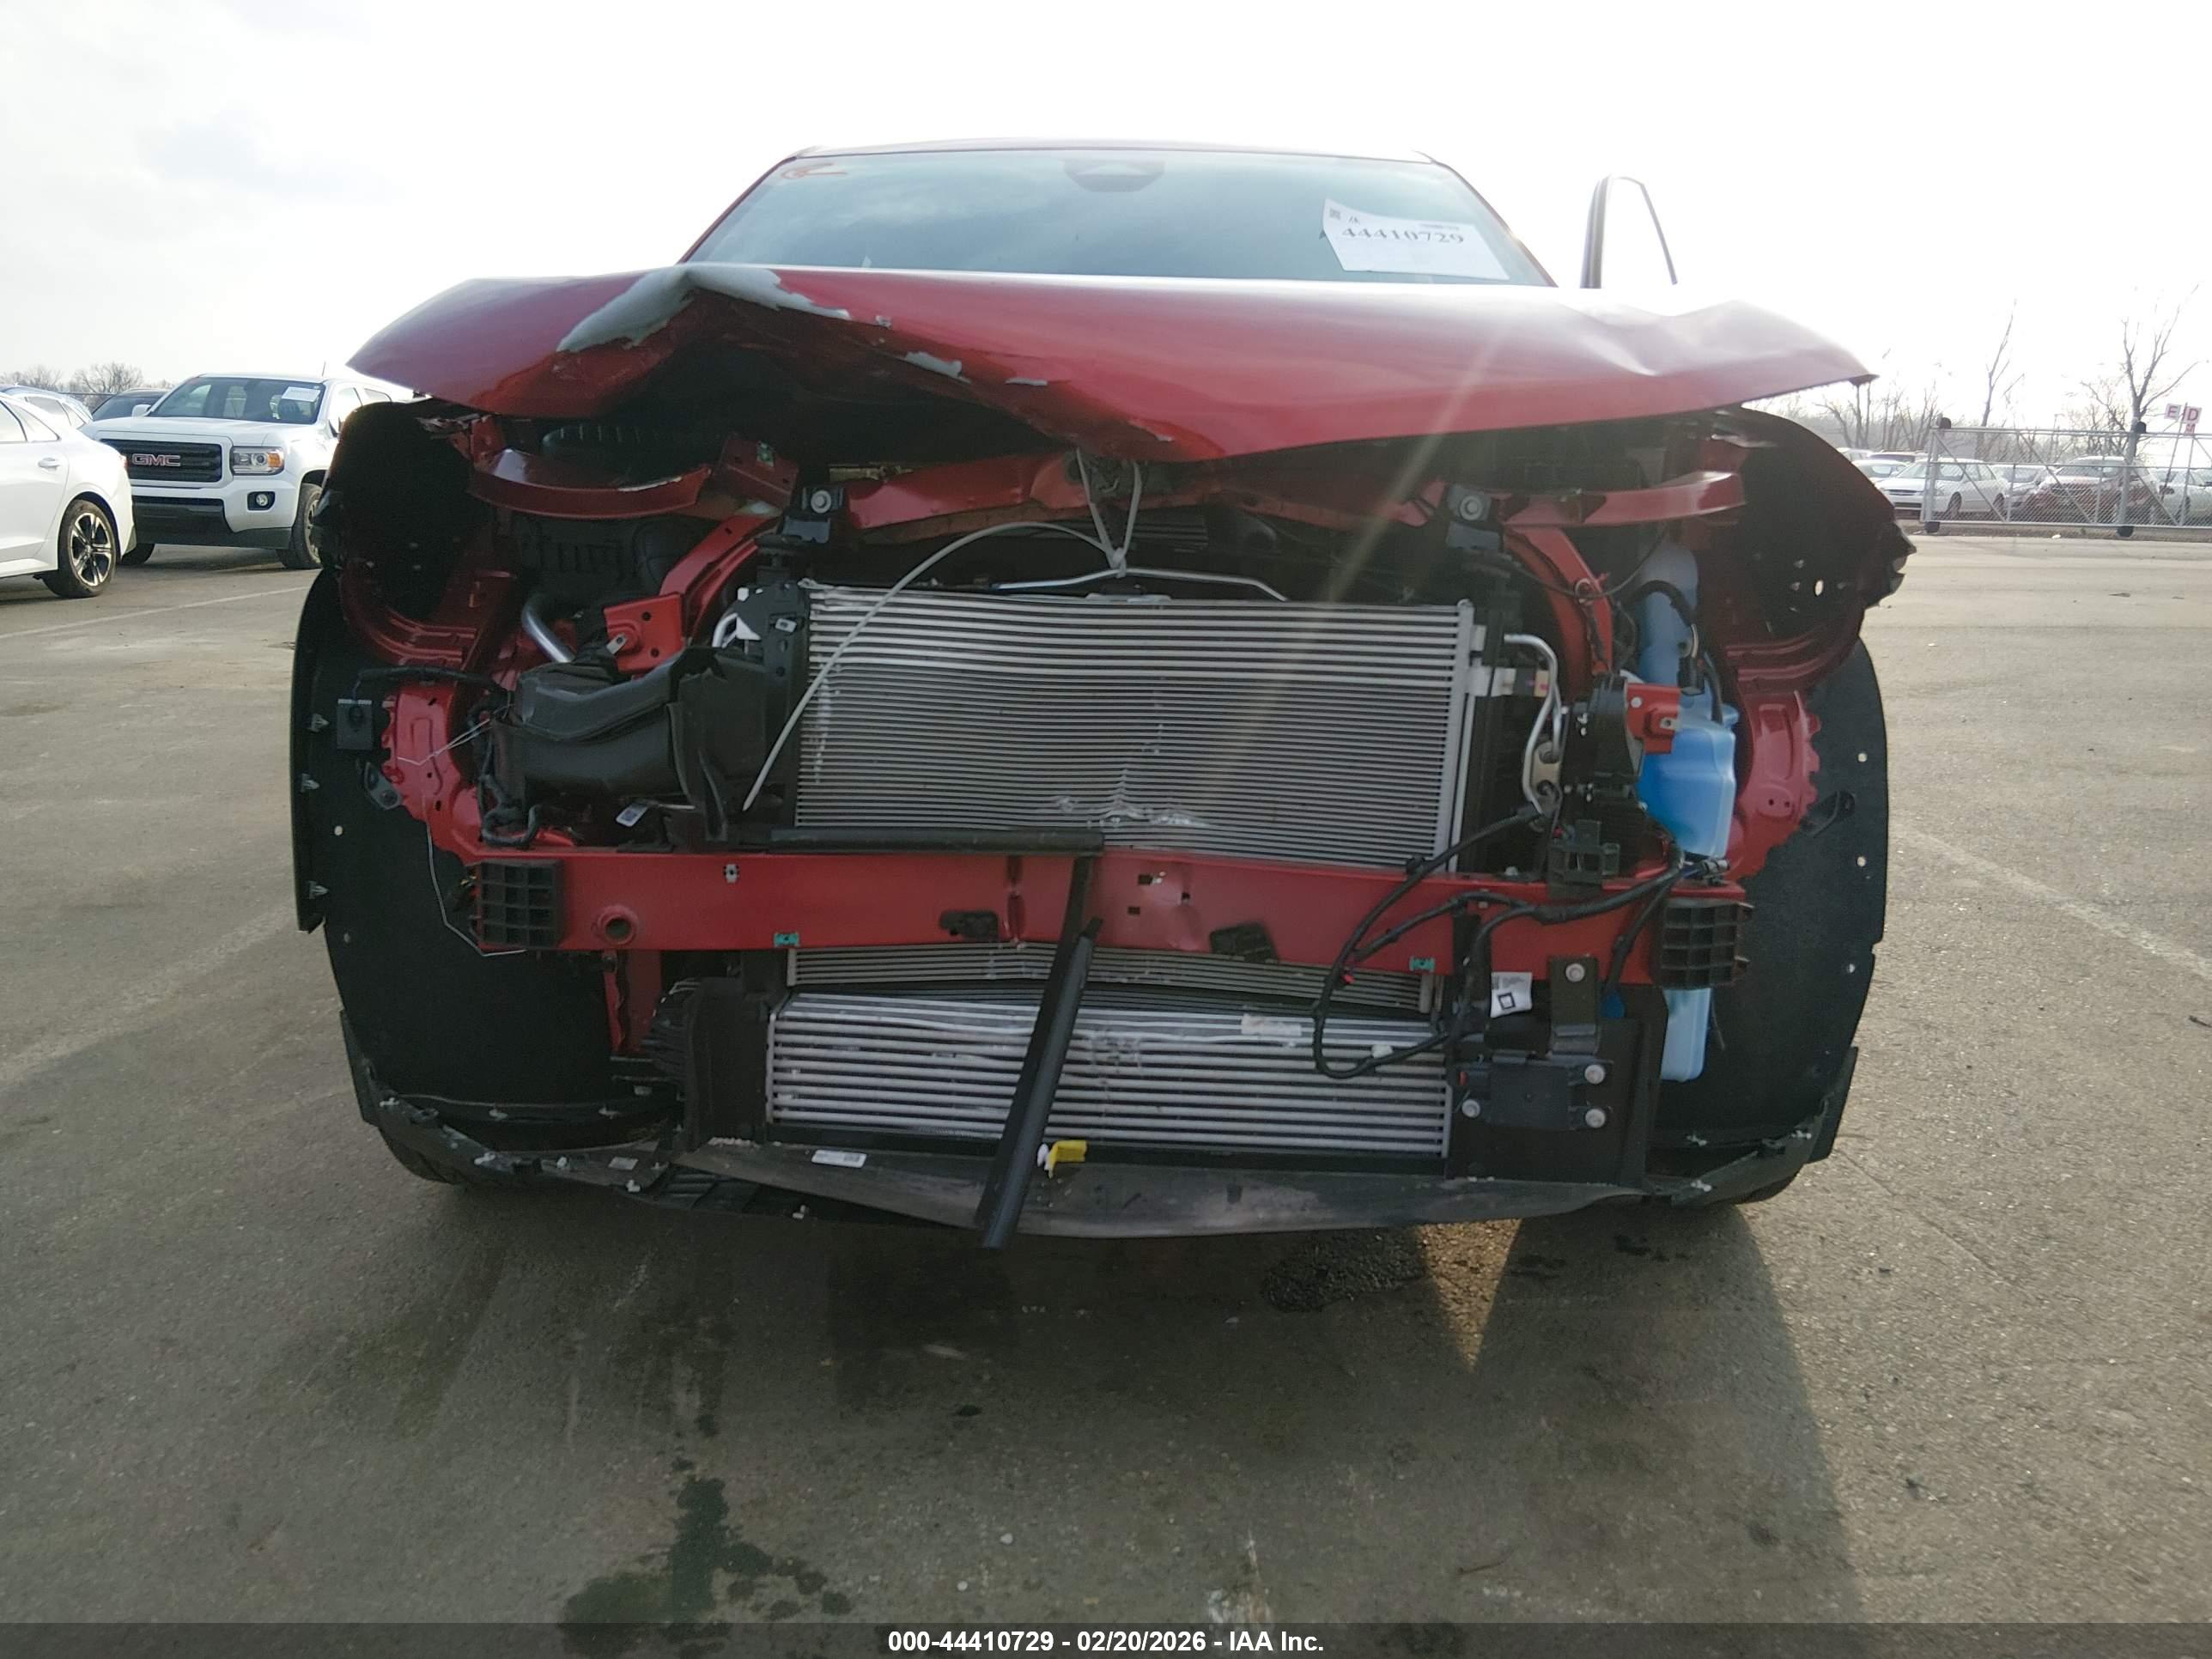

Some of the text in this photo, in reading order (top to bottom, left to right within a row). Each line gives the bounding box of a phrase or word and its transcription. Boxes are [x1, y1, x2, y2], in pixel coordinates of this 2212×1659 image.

[1342, 228, 1464, 244] 44410729
[2187, 408, 2199, 421] D
[131, 453, 181, 466] GMC
